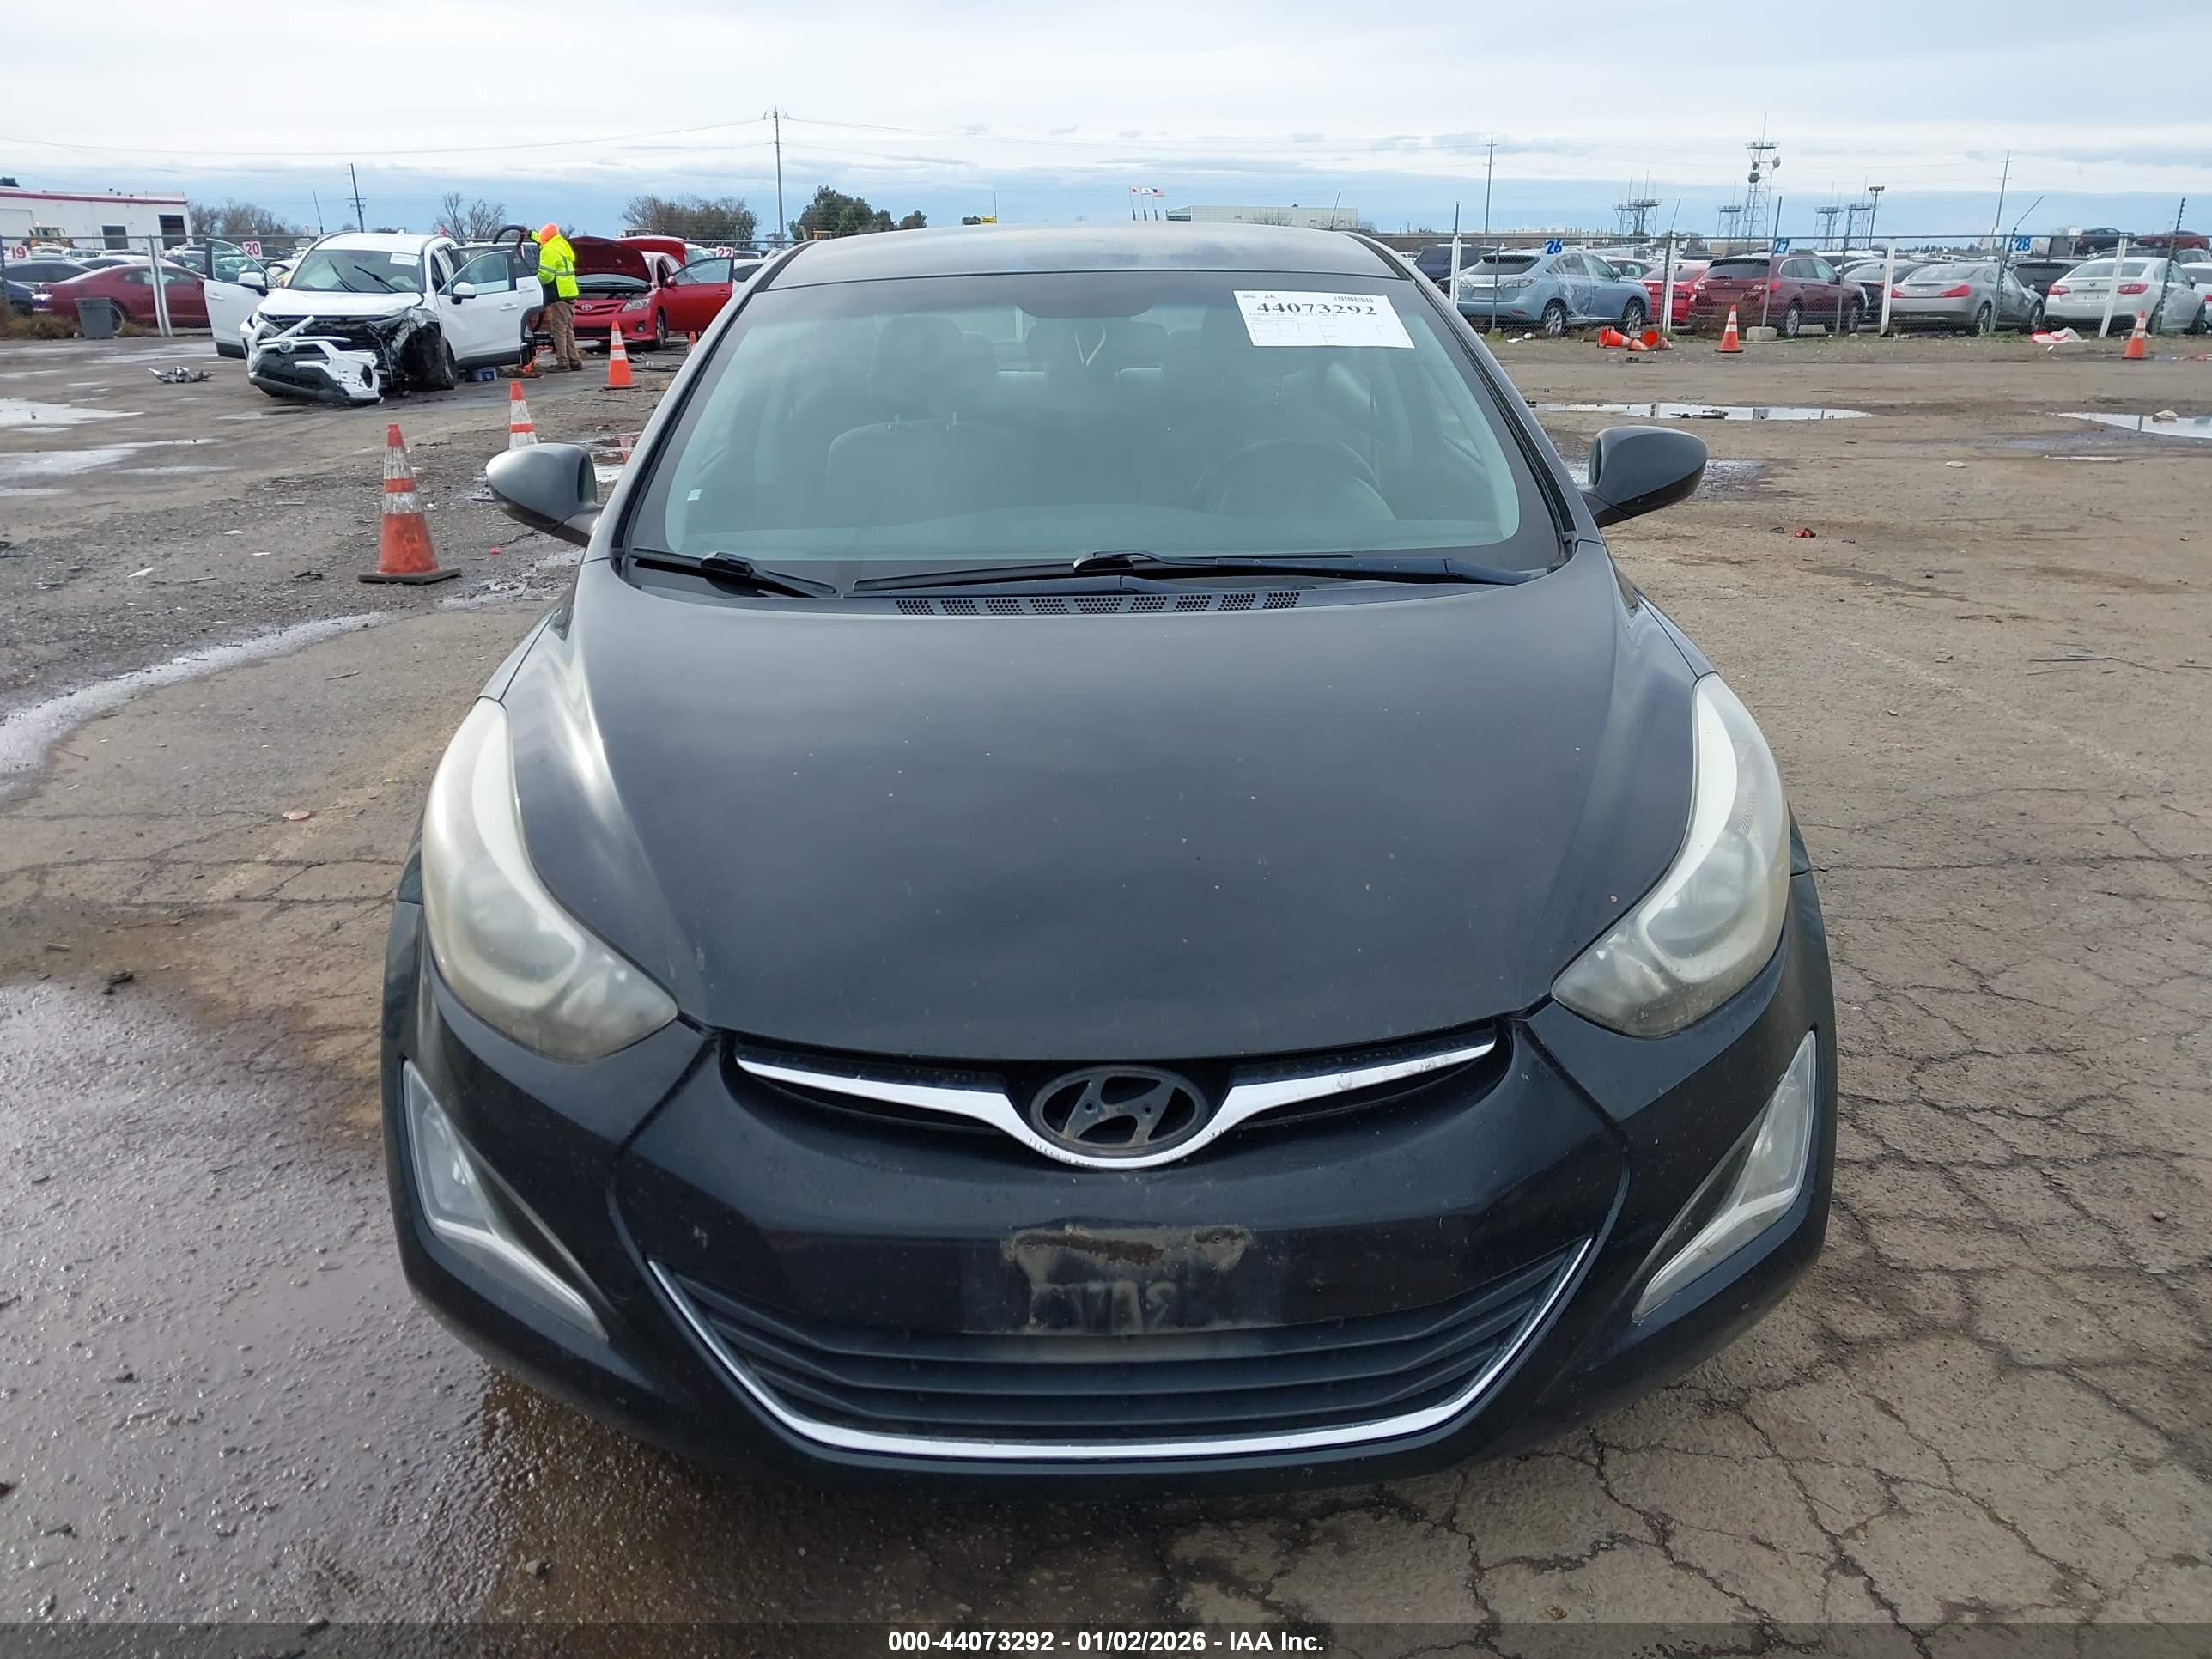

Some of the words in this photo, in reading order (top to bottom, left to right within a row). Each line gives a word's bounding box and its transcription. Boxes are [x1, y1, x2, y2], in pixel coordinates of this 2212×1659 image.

[245, 242, 260, 256] 20
[1545, 238, 1563, 255] 26
[2014, 236, 2031, 252] 28
[11, 246, 27, 259] 19
[1256, 302, 1378, 316] 44073292
